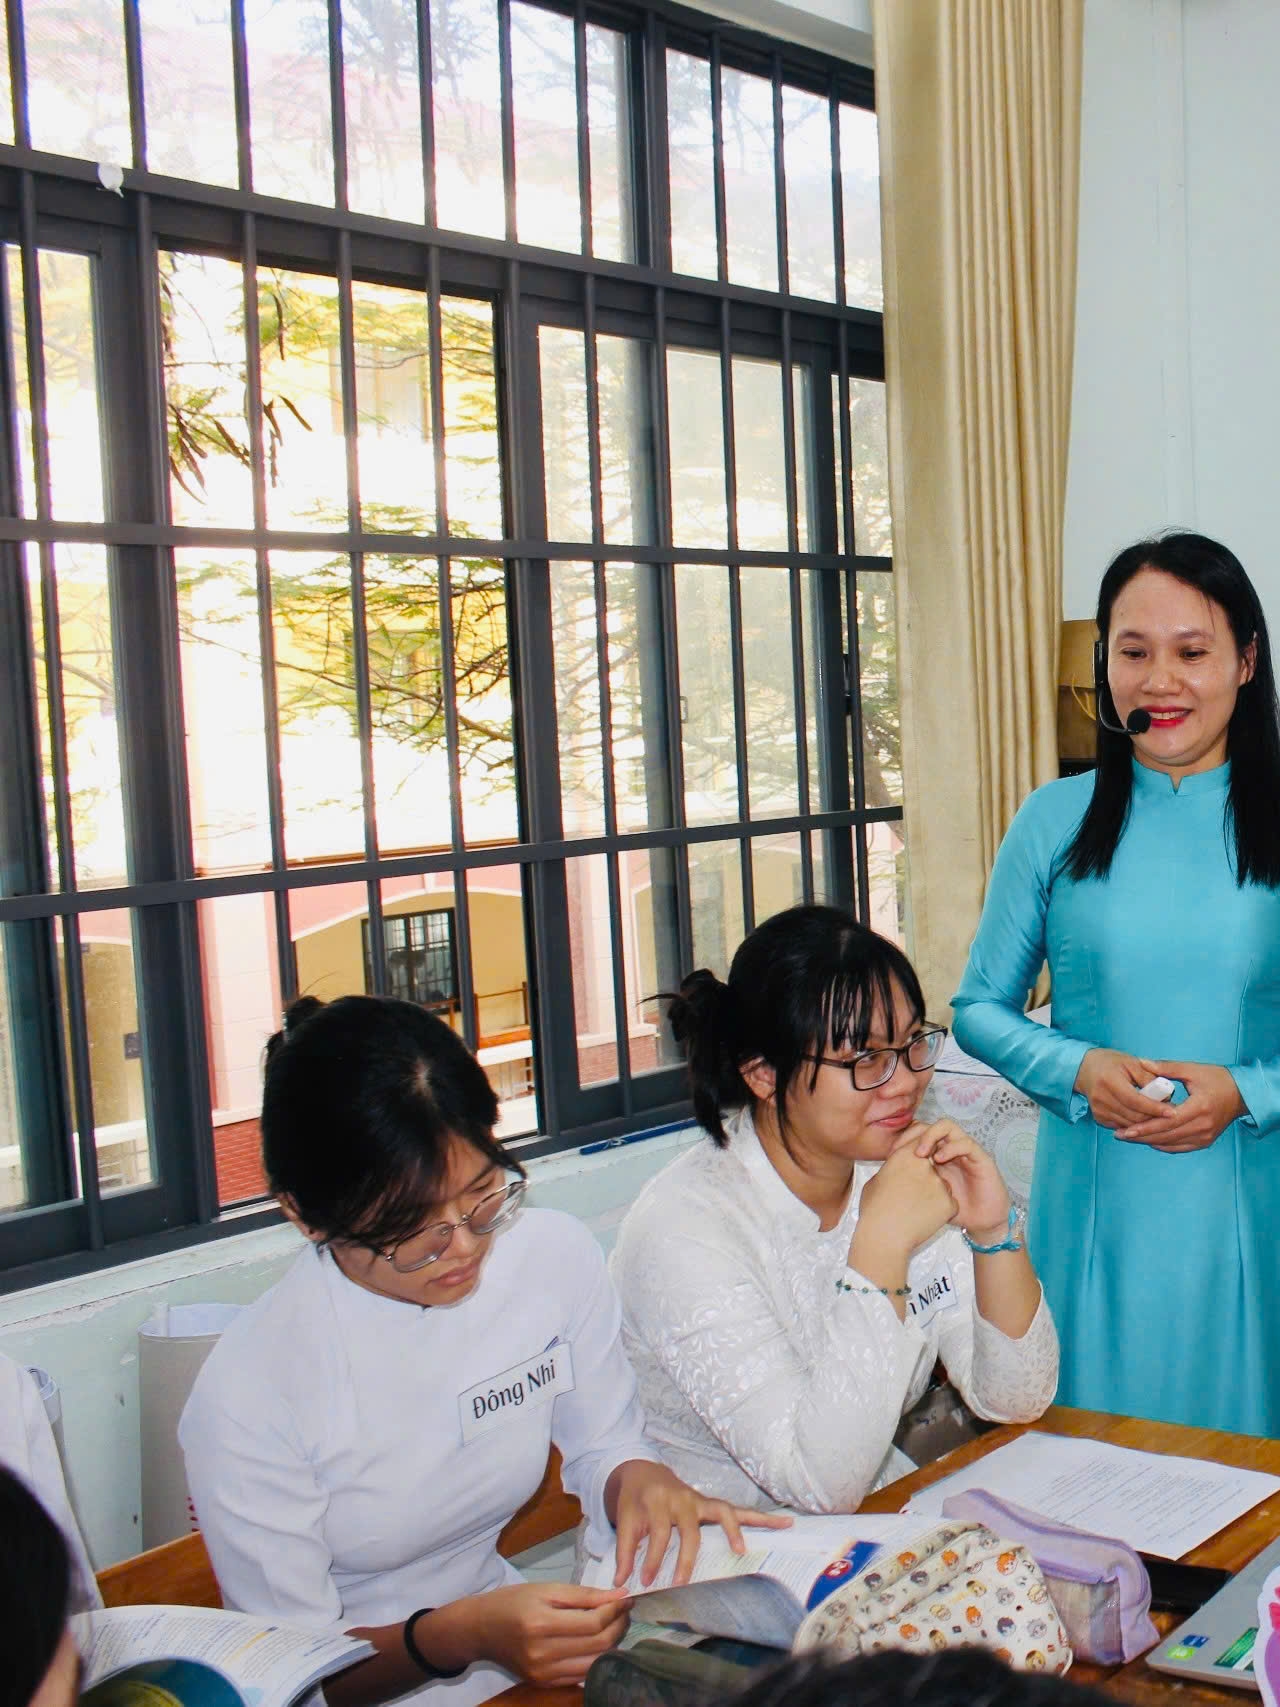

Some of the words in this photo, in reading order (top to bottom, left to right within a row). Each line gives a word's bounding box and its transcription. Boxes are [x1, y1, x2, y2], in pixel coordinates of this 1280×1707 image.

[918, 1276, 951, 1310] Nhật
[472, 1382, 525, 1419] Đông
[527, 1358, 556, 1392] Nhi
